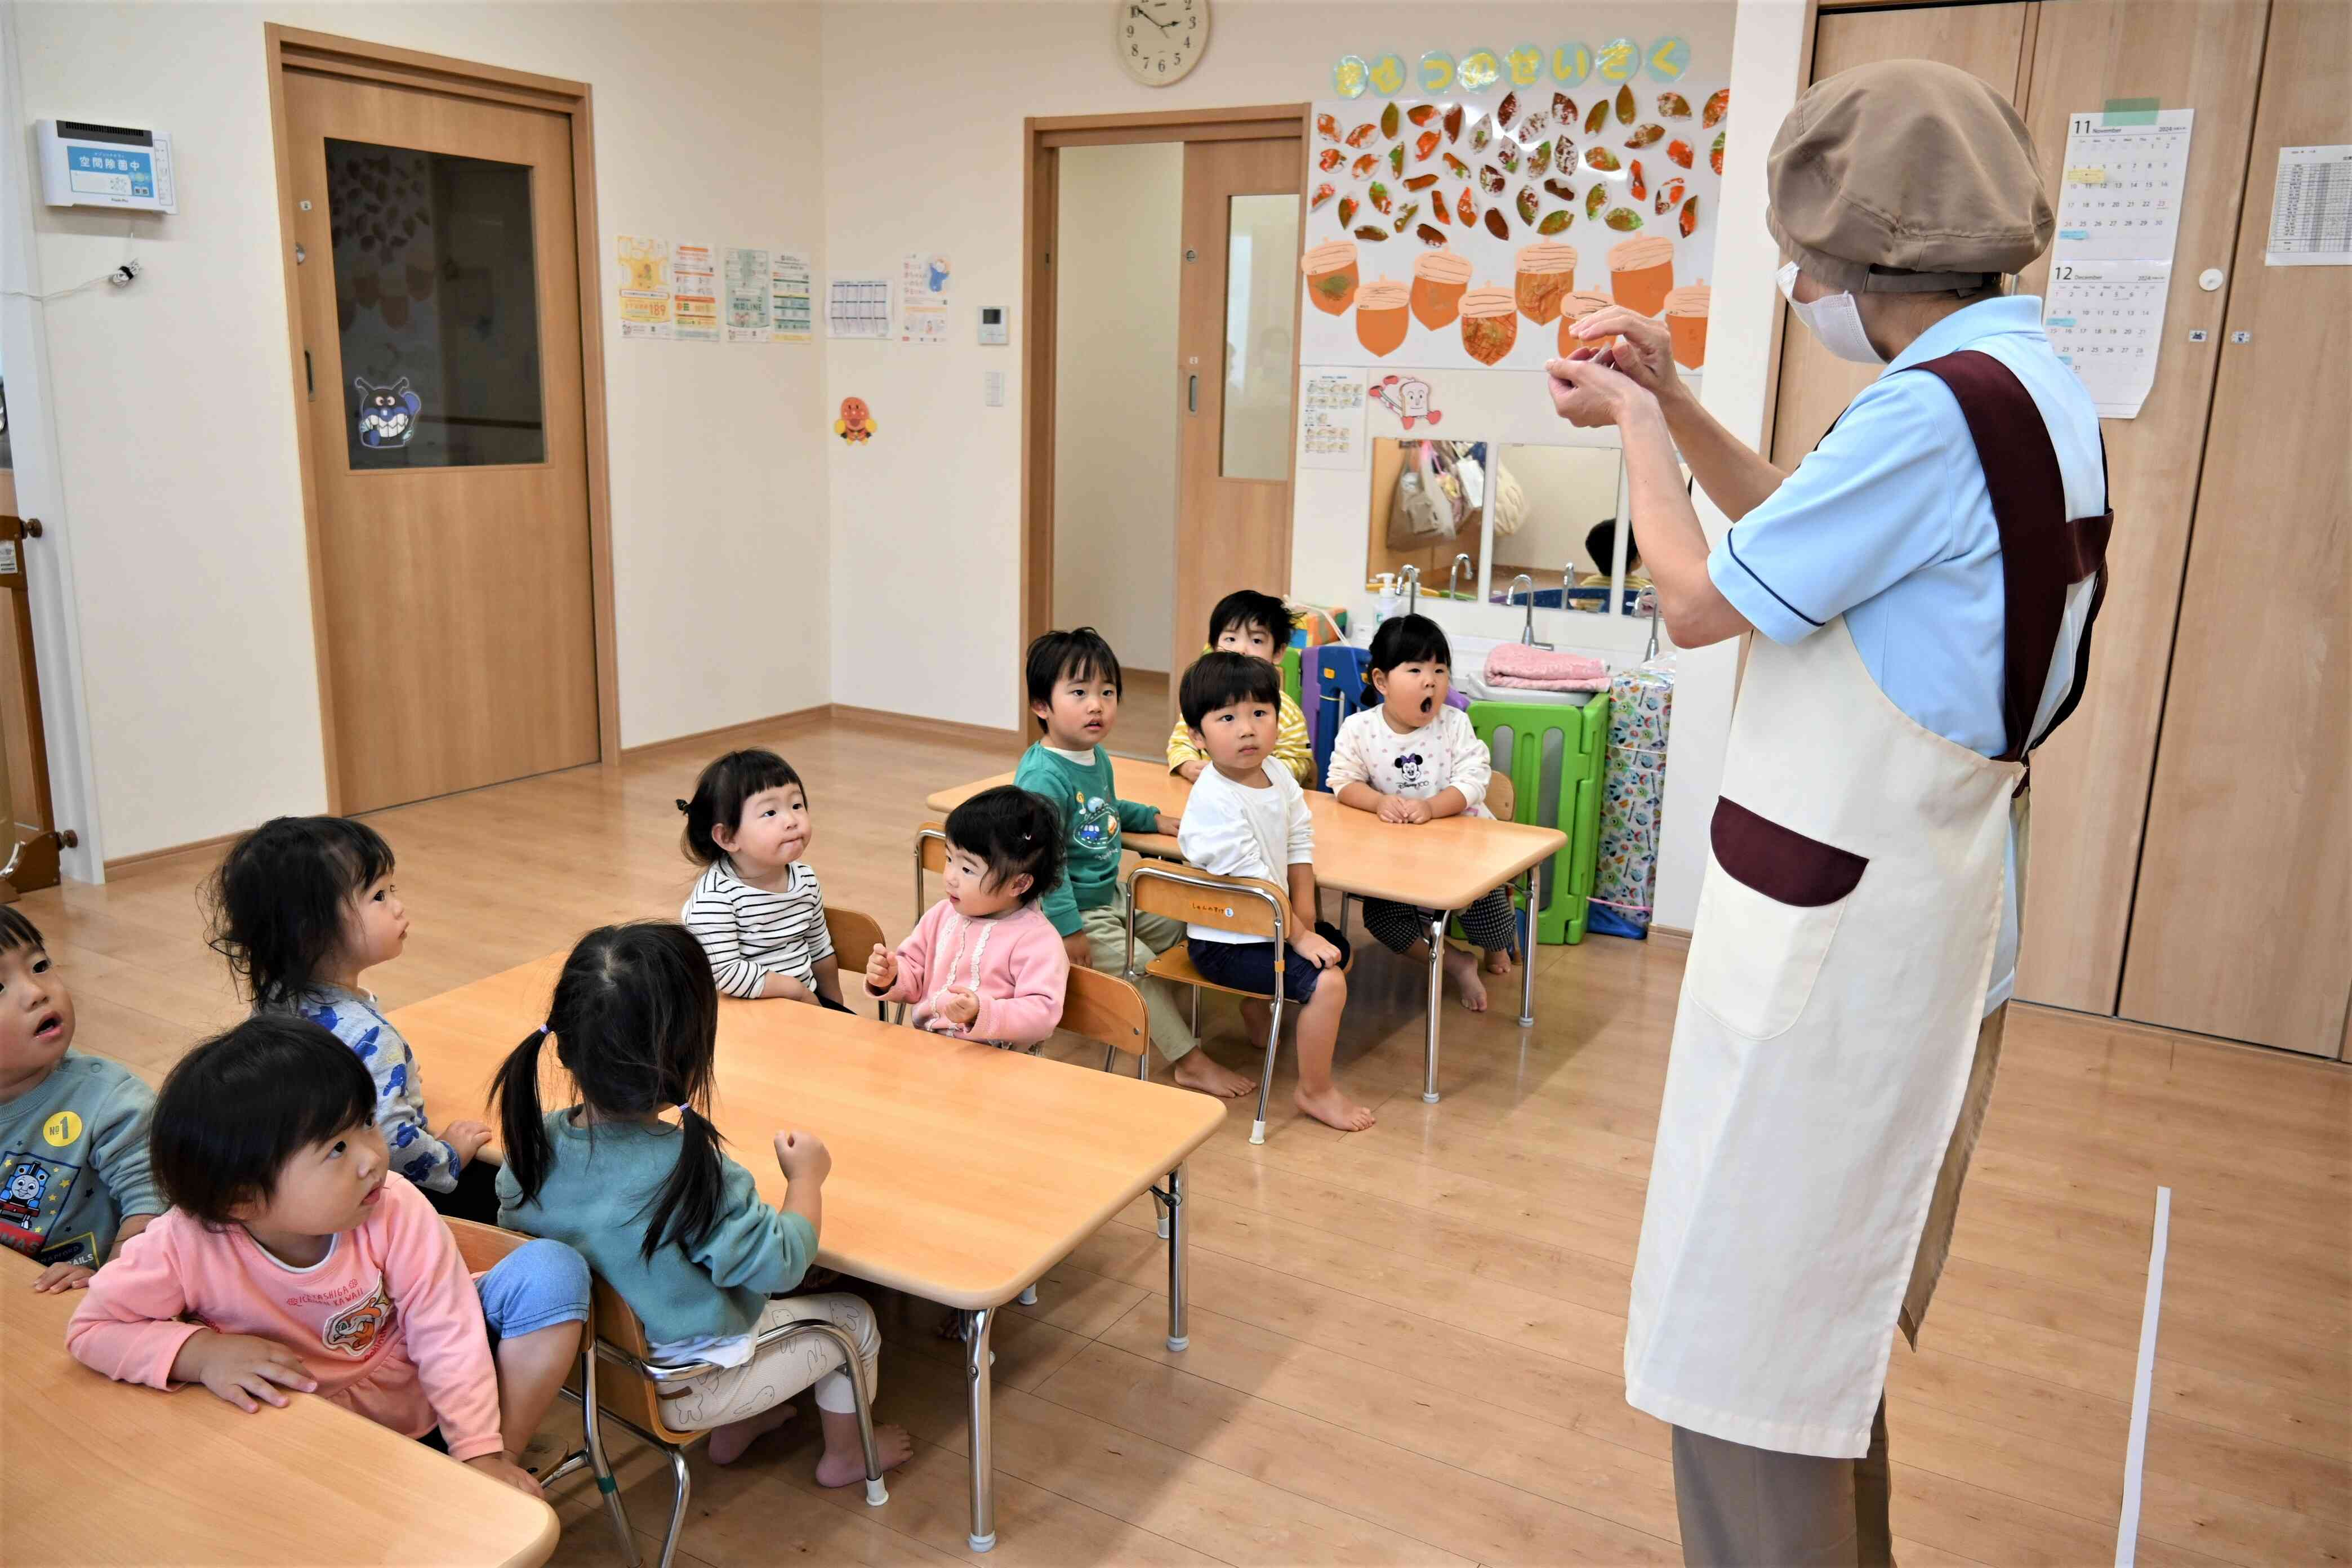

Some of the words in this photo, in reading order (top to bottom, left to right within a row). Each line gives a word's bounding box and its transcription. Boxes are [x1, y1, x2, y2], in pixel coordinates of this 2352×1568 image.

[1130, 5, 1140, 18] 10
[1189, 16, 1196, 29] 3
[1126, 25, 1134, 38] 9
[1184, 36, 1190, 48] 4
[1132, 44, 1138, 56] 8
[1143, 57, 1149, 69] 7
[1158, 59, 1165, 72] 6
[1174, 53, 1181, 65] 5
[2074, 120, 2090, 133] 11
[79, 156, 140, 171] 空間除菌中
[2055, 267, 2072, 280] 12
[649, 304, 666, 315] 189
[333, 1288, 364, 1306] KAWAII
